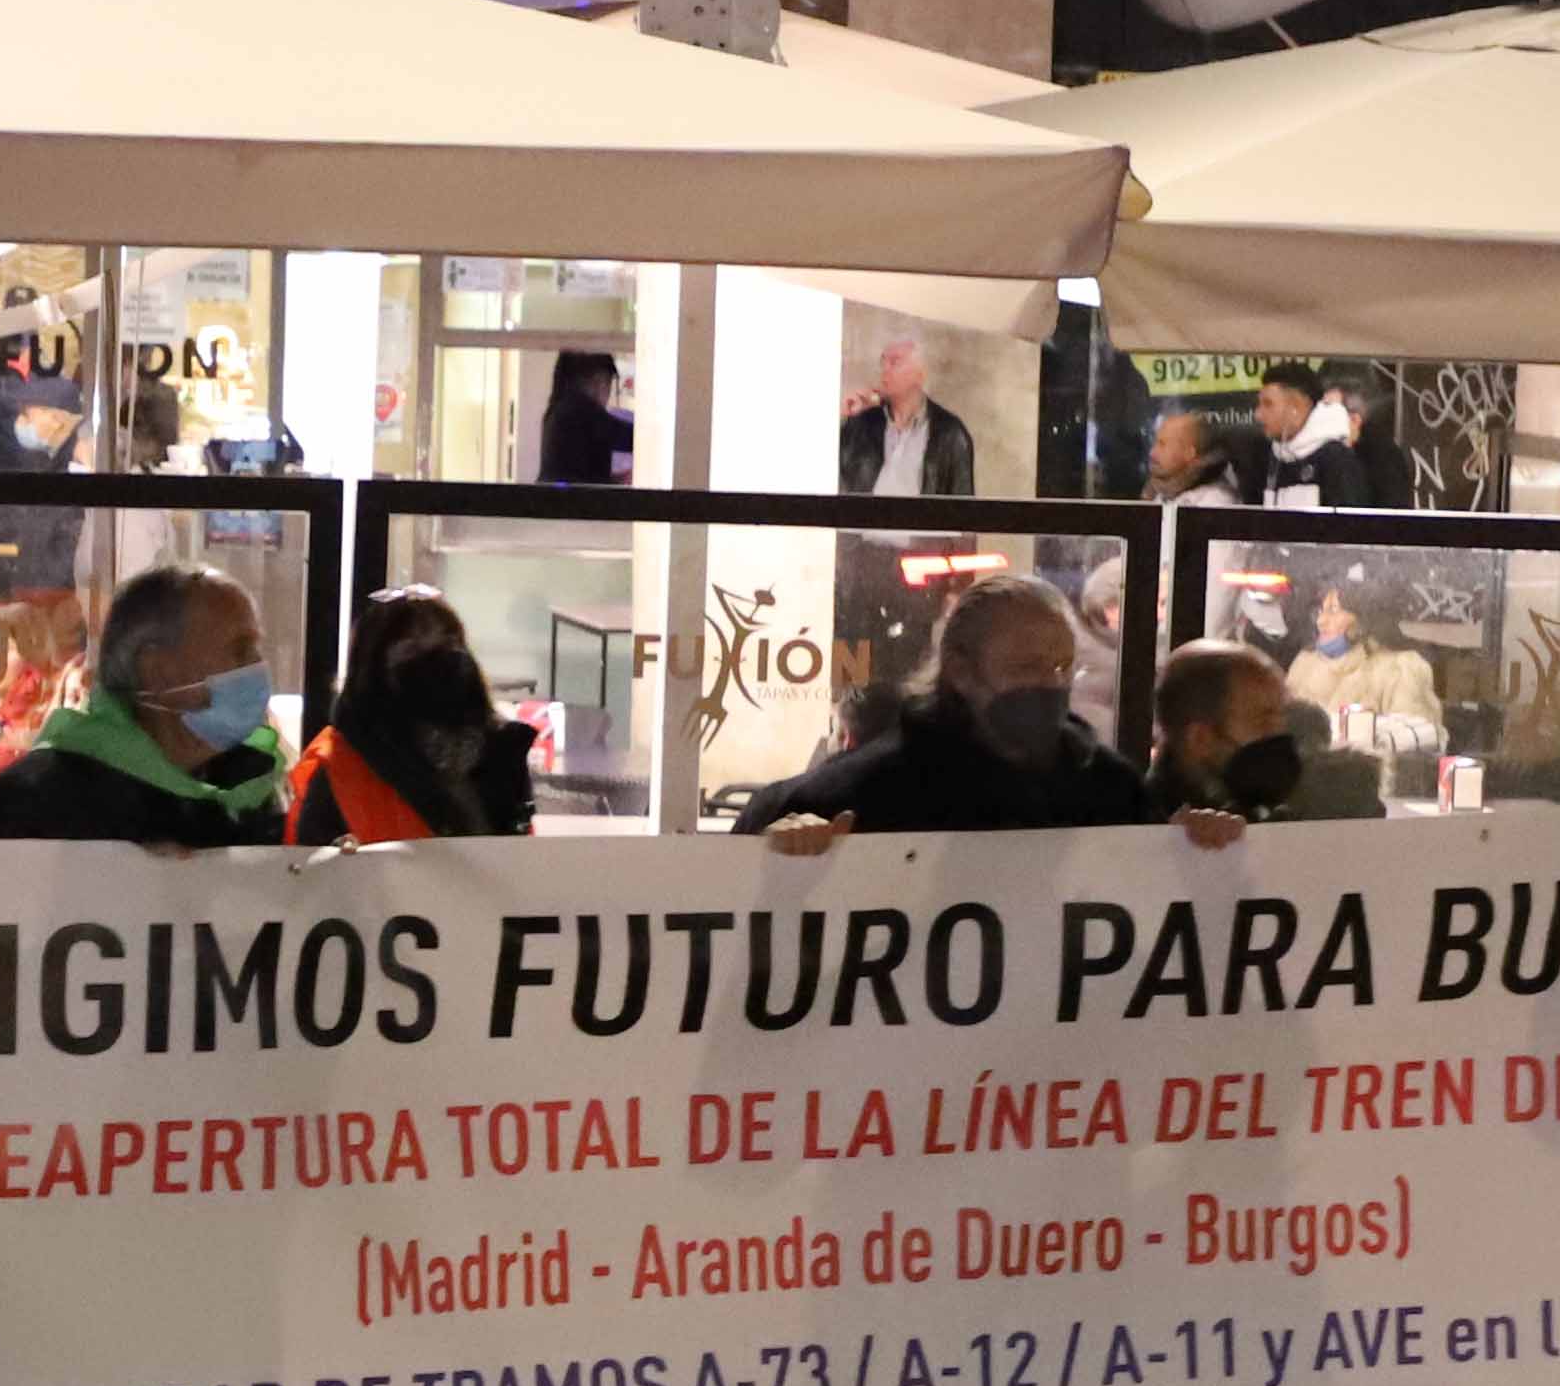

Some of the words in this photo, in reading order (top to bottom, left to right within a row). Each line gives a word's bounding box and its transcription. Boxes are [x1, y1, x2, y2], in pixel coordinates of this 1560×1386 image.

[489, 901, 1005, 1039] FUTURO
[1056, 892, 1374, 1023] PARA
[446, 1096, 661, 1178] TOTAL
[688, 1091, 776, 1165] DE
[803, 1090, 895, 1159] LA
[922, 1069, 1128, 1156] LÍNEA
[1154, 1072, 1278, 1143] DEL
[1304, 1058, 1474, 1133] TREN
[357, 1229, 570, 1327] (Madrid
[631, 1216, 841, 1300] Aranda
[862, 1211, 933, 1285] de
[957, 1208, 1124, 1280] Duero
[1186, 1175, 1410, 1277] Burgos)
[1102, 1318, 1234, 1386] A-11
[1314, 1306, 1423, 1371] AVE
[1447, 1316, 1516, 1362] en
